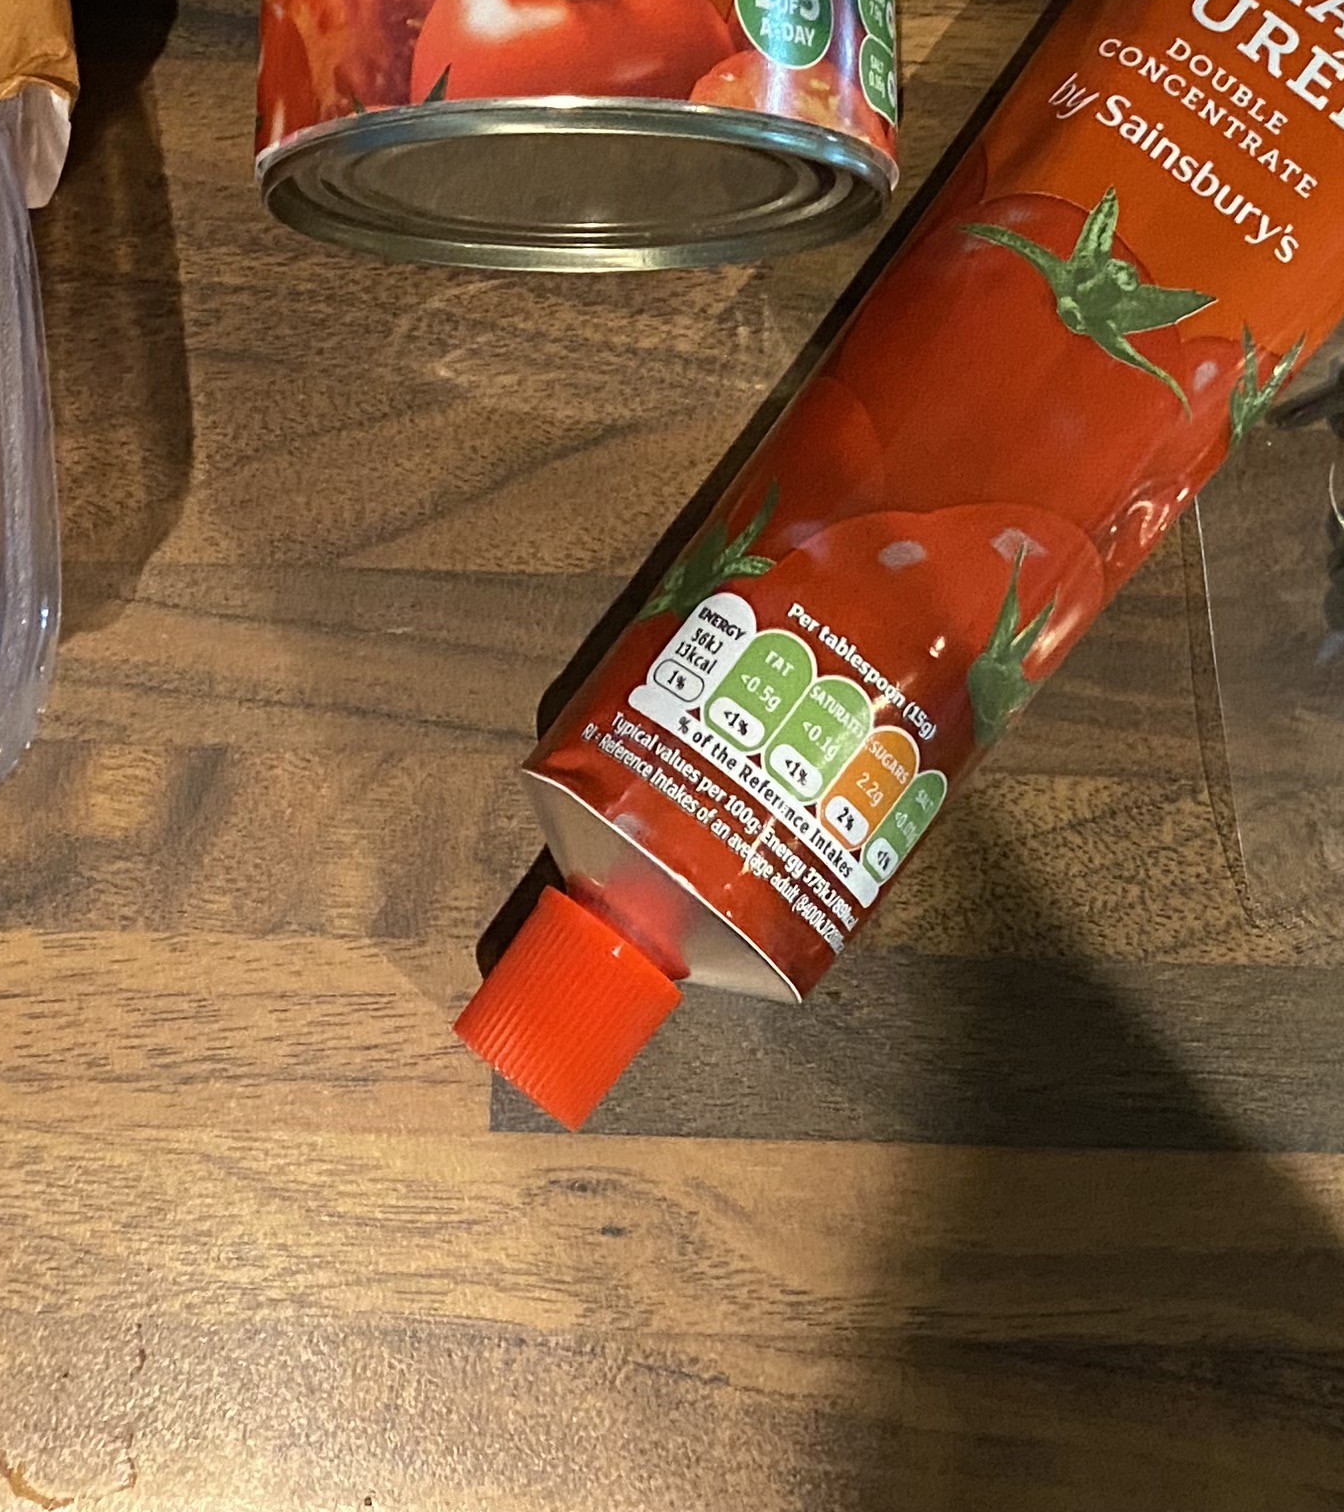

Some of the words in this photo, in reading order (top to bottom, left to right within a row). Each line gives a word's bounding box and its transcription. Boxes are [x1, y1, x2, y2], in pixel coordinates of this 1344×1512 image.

[1165, 37, 1289, 135] DOUBLE
[1097, 37, 1318, 200] CONCENTRATE
[1047, 72, 1100, 120] by
[1095, 93, 1300, 264] Sainsbury's
[698, 607, 746, 641] ENERGY
[675, 641, 718, 675] 13kcal
[765, 651, 794, 677] FAT
[788, 603, 819, 632] Per
[819, 626, 906, 708] tablespoon
[903, 702, 937, 740] (15g)
[667, 670, 686, 690] 1%
[741, 674, 781, 713] <0.5g
[724, 710, 748, 736] <1%
[803, 721, 840, 761] <0.1g
[785, 758, 808, 786] <1%
[869, 740, 909, 785] SUGARS
[612, 711, 659, 751] Typical
[656, 743, 702, 784] values
[696, 776, 727, 802] per
[763, 825, 807, 879] Energy
[678, 716, 692, 734] %
[692, 731, 714, 748] of
[710, 745, 738, 771] the
[738, 764, 810, 834] Reference
[809, 828, 854, 878] Intakes
[857, 772, 884, 807] 2.2g
[598, 733, 654, 781] Reference
[651, 767, 698, 815] Intakes
[696, 806, 718, 825] of
[710, 819, 732, 840] an
[727, 833, 775, 879] average
[769, 872, 801, 904] adult
[837, 806, 855, 832] 2%
